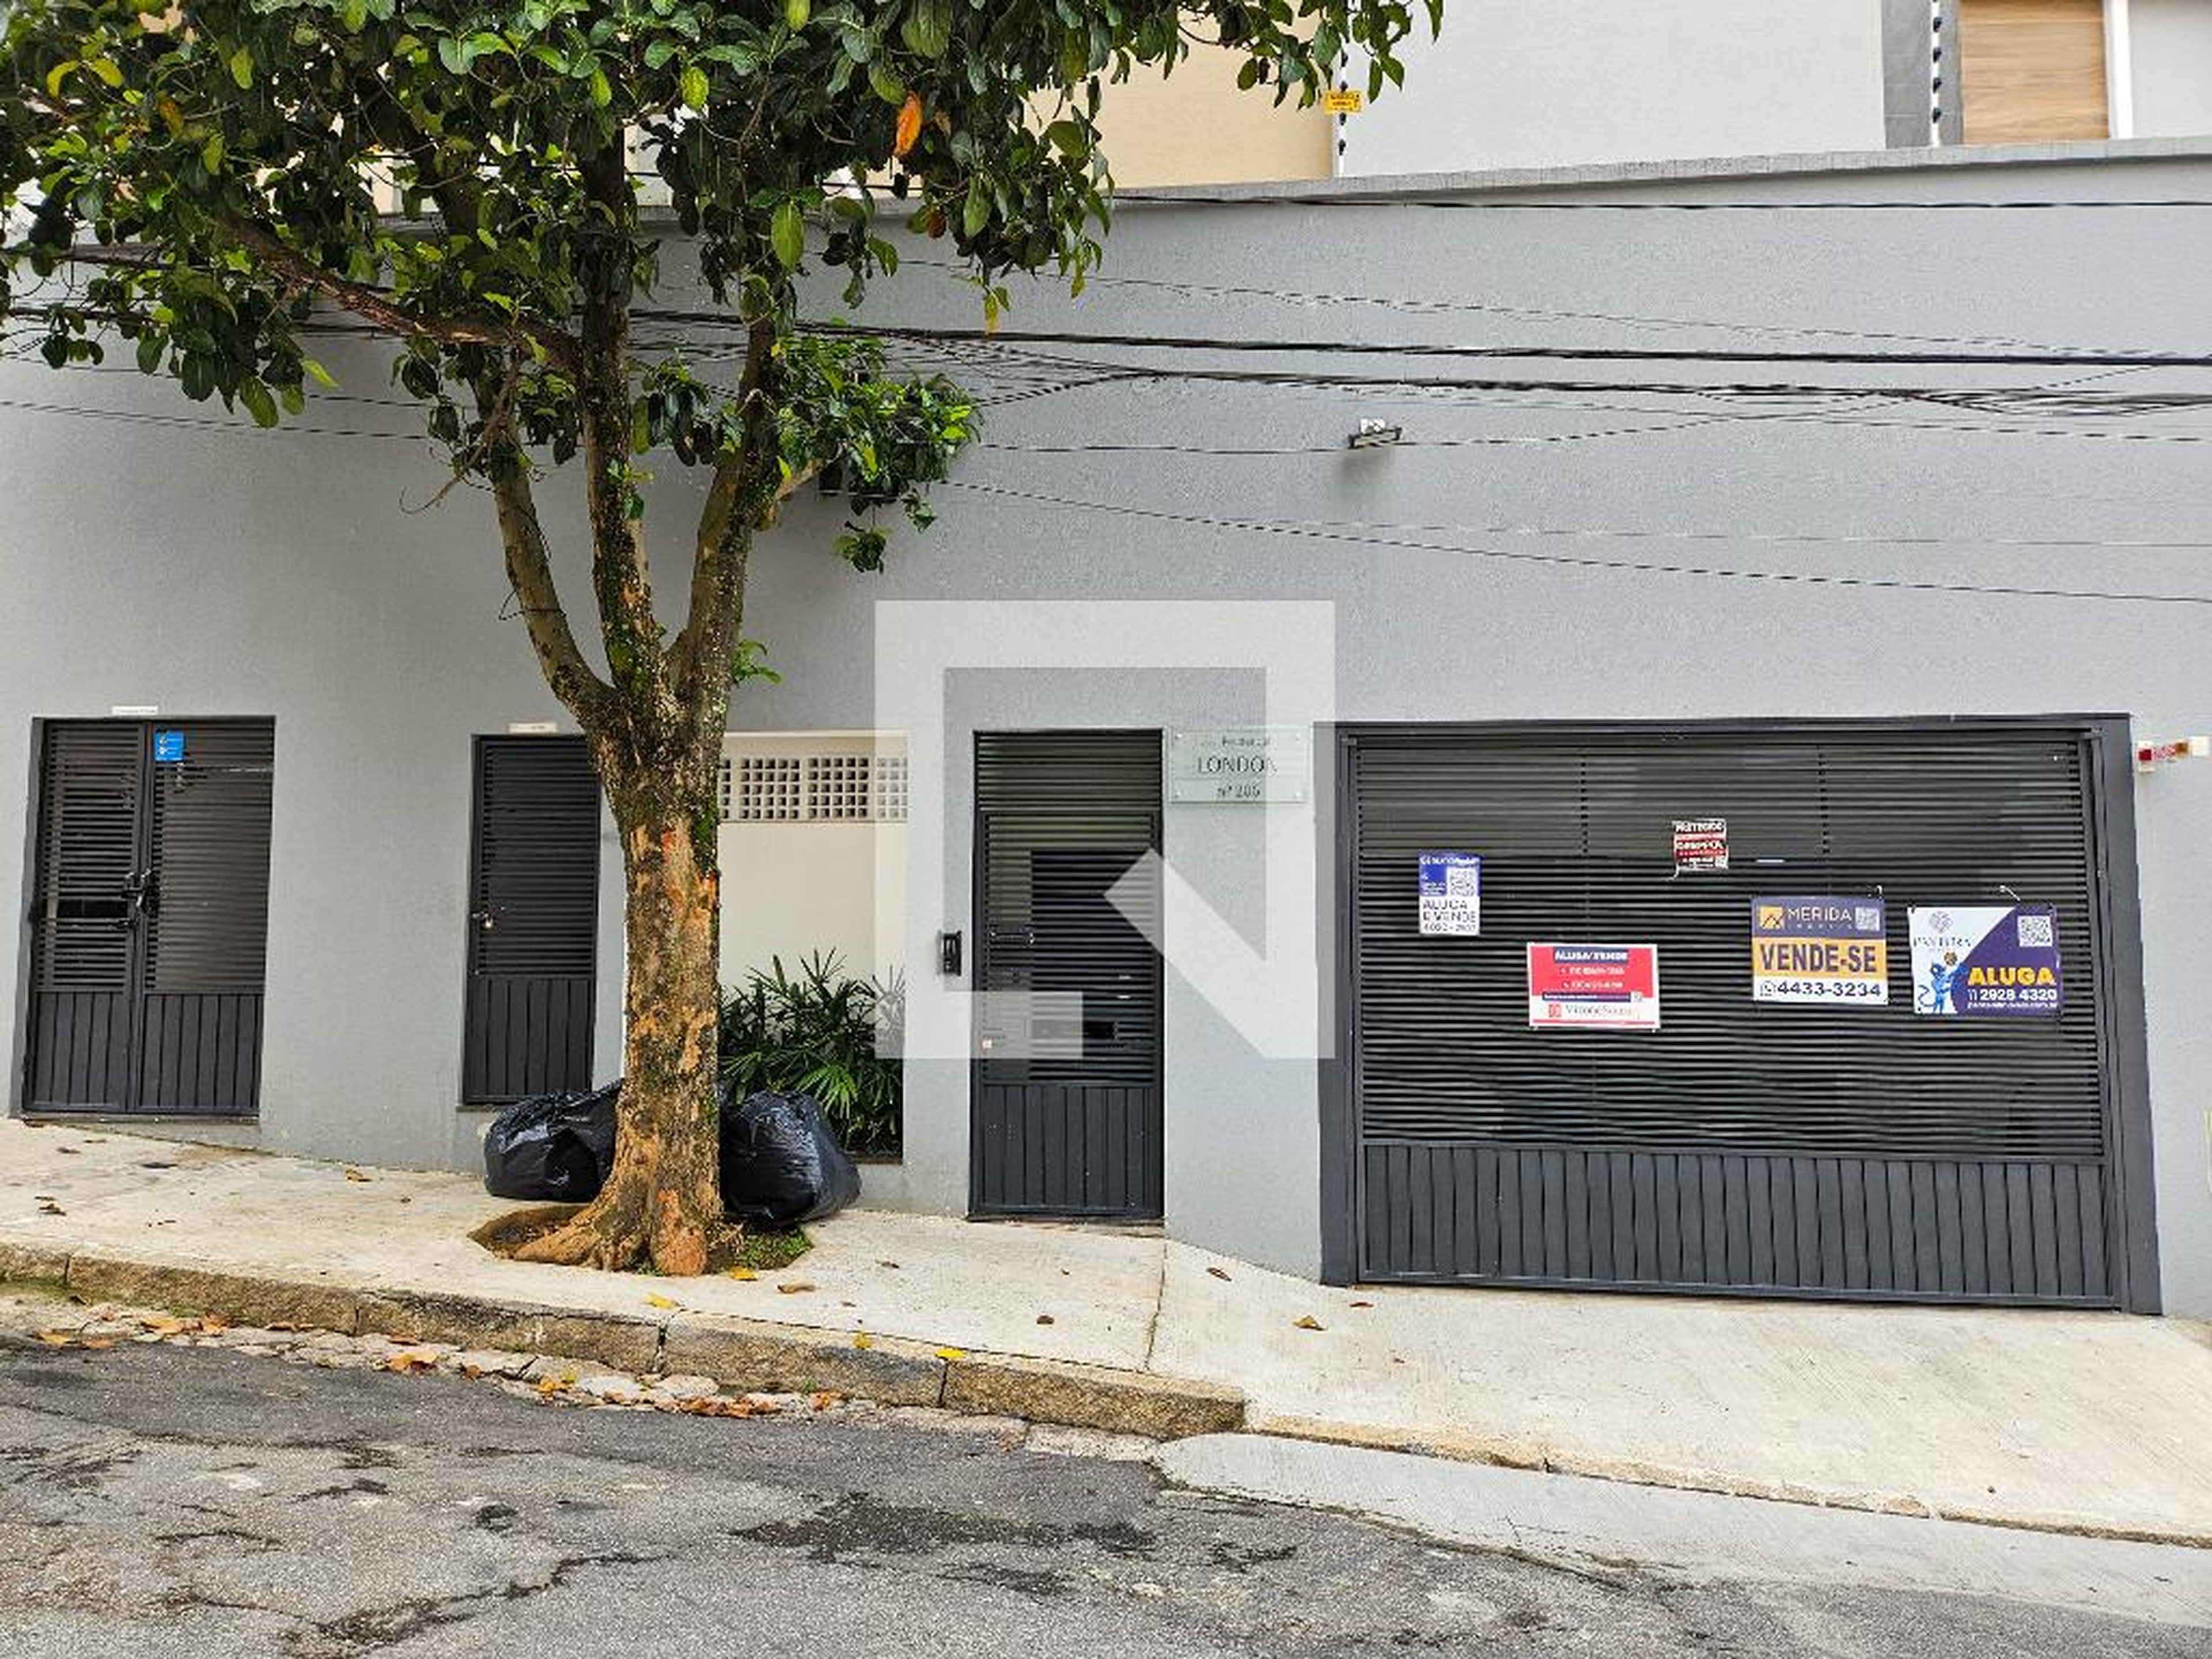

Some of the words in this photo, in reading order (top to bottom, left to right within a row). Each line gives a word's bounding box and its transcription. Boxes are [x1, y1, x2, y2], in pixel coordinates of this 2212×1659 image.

[1198, 755, 1277, 773] LONDON
[1760, 944, 1877, 973] VENDE-SE
[1967, 967, 2056, 986] ALUGA
[1778, 981, 1881, 997] 4433-3234
[1980, 989, 2016, 1001] 2928
[2019, 989, 2058, 1001] 4320
